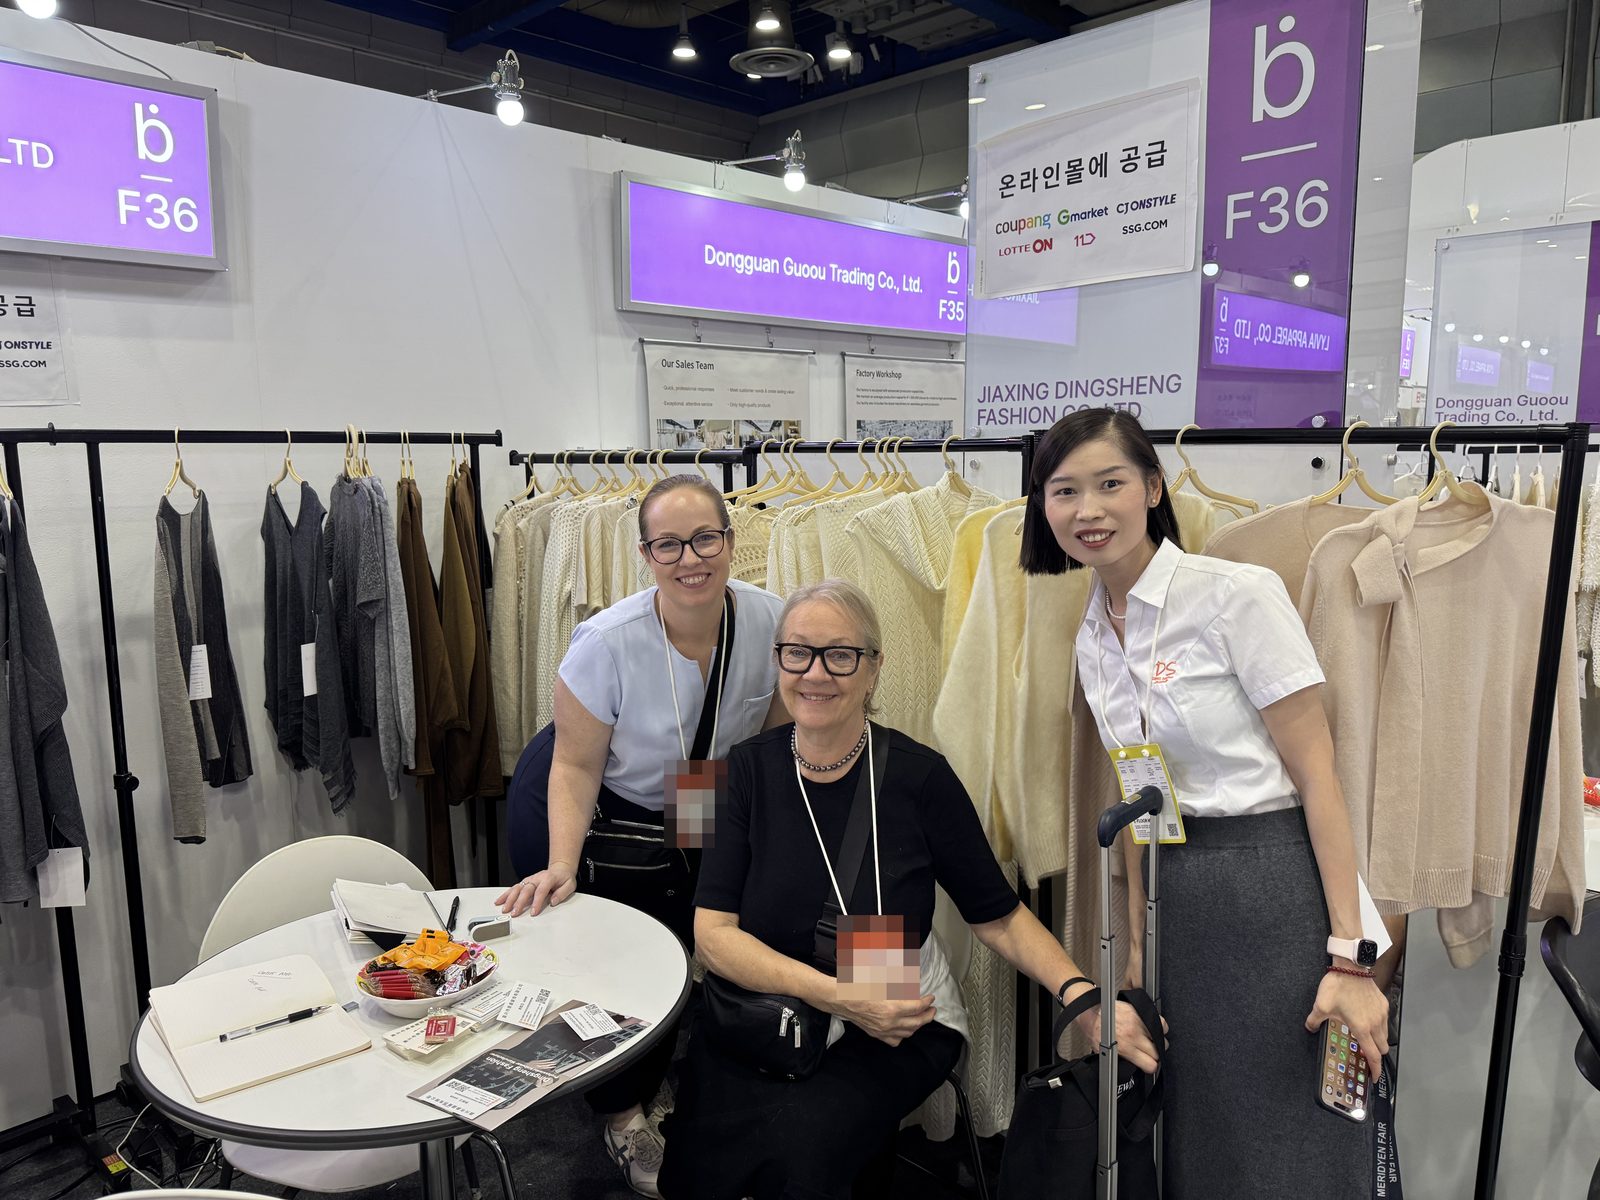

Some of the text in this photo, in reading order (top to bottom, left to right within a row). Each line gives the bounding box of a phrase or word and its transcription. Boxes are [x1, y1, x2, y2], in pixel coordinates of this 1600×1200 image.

[998, 140, 1168, 199] 온라인몰에 공급
[117, 188, 199, 233] F36
[1057, 205, 1109, 226] Gmarket
[1225, 179, 1329, 240] F36
[995, 213, 1052, 235] coupang
[1122, 218, 1168, 235] SSG.COM
[998, 237, 1053, 257] LOTTE ON
[704, 244, 923, 295] Dongguan Guoou Trading Co., Ltd.
[938, 299, 965, 322] F35
[4, 340, 52, 350] ONSTYLE
[661, 358, 715, 370] Our Sales Team
[856, 369, 902, 380] Factory Workshop
[977, 373, 1182, 404] JIAXING DINGSHENG
[1435, 396, 1512, 411] Dongguan
[1517, 394, 1569, 407] Guoou
[977, 405, 1056, 426] FASHION
[1435, 409, 1559, 425] Trading Co., Ltd.
[486, 1056, 514, 1070] Fashion
[1377, 1121, 1387, 1198] MERIDYEN FAIR
[1389, 1162, 1398, 1184] FAIR
